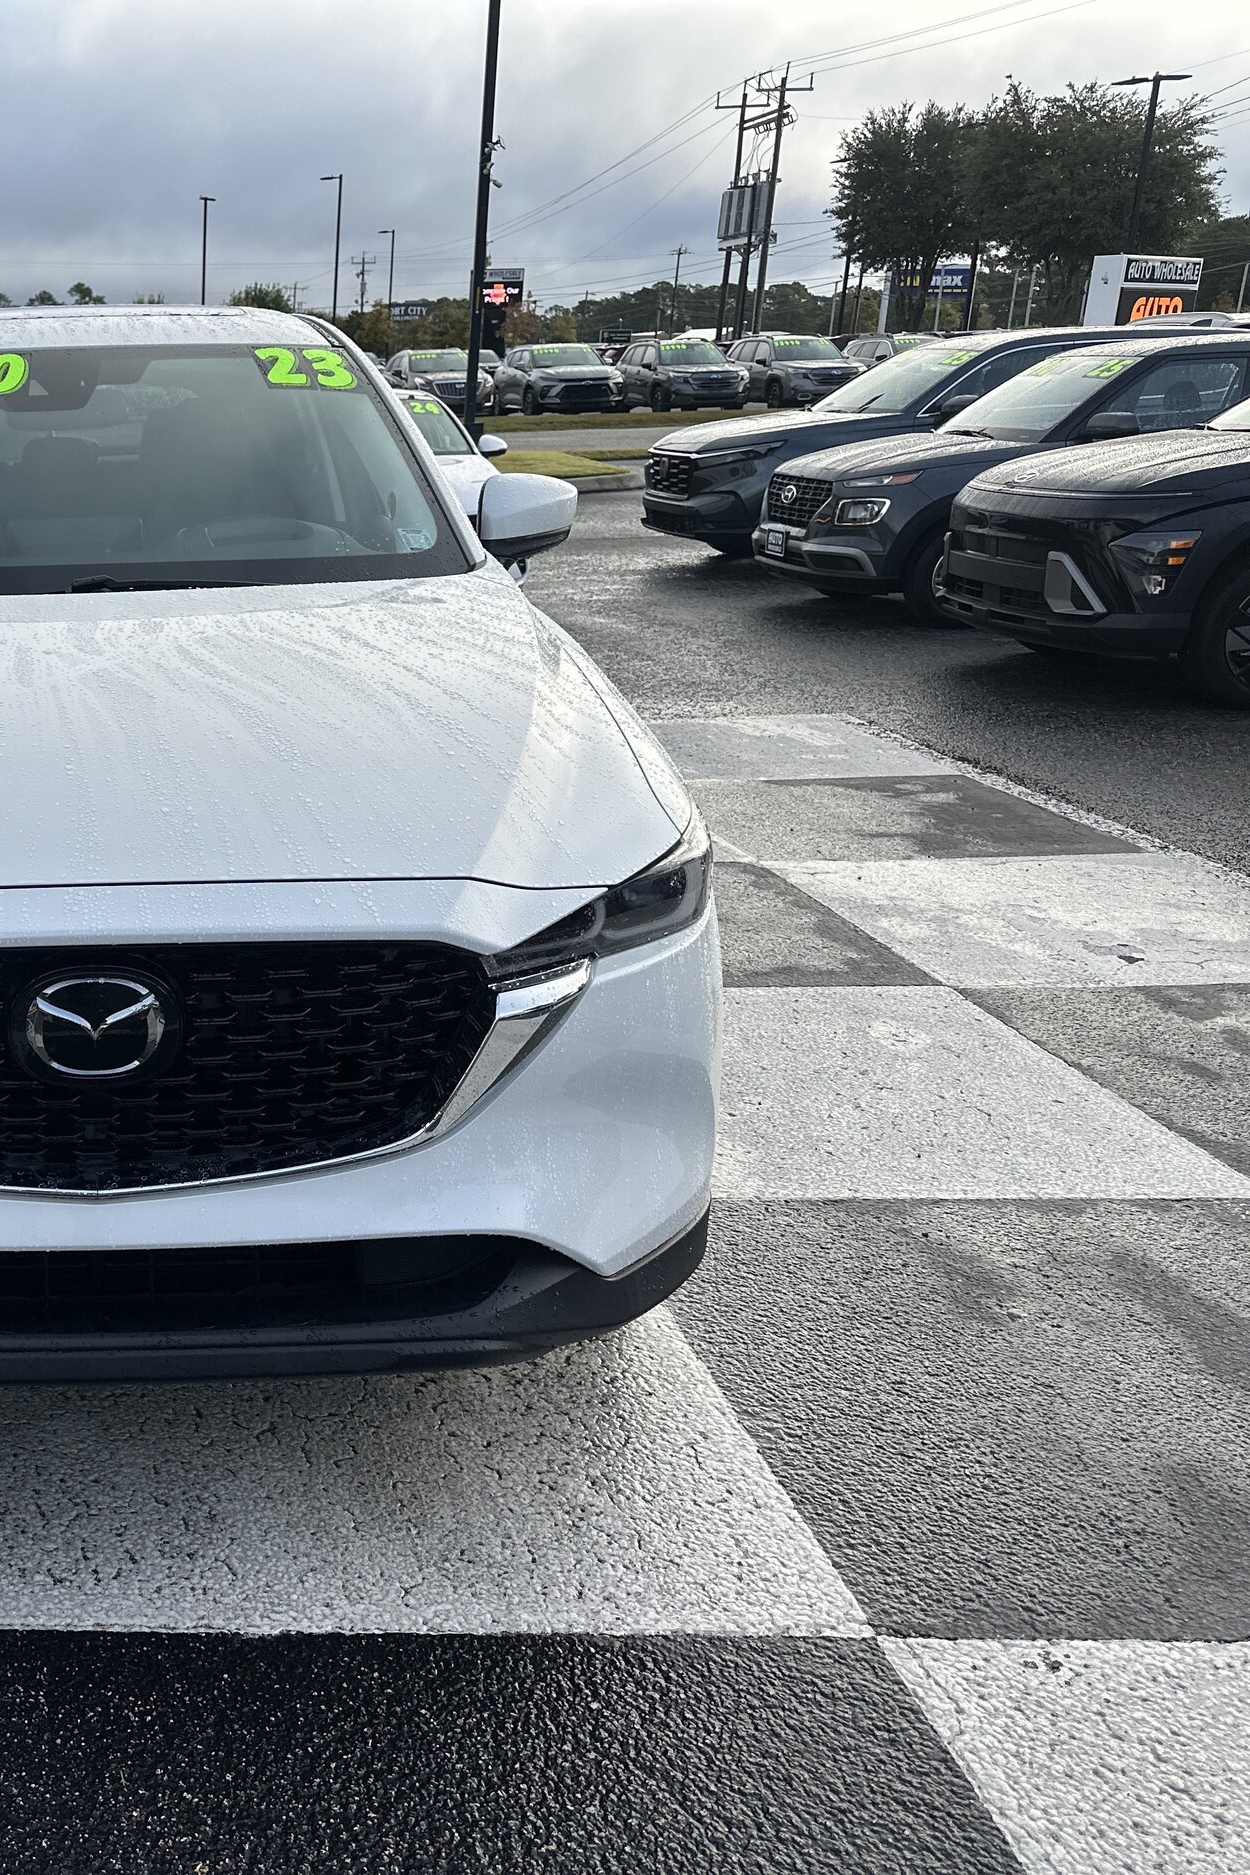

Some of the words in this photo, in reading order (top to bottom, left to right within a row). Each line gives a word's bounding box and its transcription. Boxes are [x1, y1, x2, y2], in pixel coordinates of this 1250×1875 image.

[1128, 261, 1152, 280] AUTO
[1154, 261, 1200, 281] WHOLESALE
[407, 306, 428, 316] CITY
[1130, 296, 1183, 322] AUTO
[940, 350, 979, 366] 25
[254, 347, 358, 390] 23
[1085, 360, 1134, 378] 25
